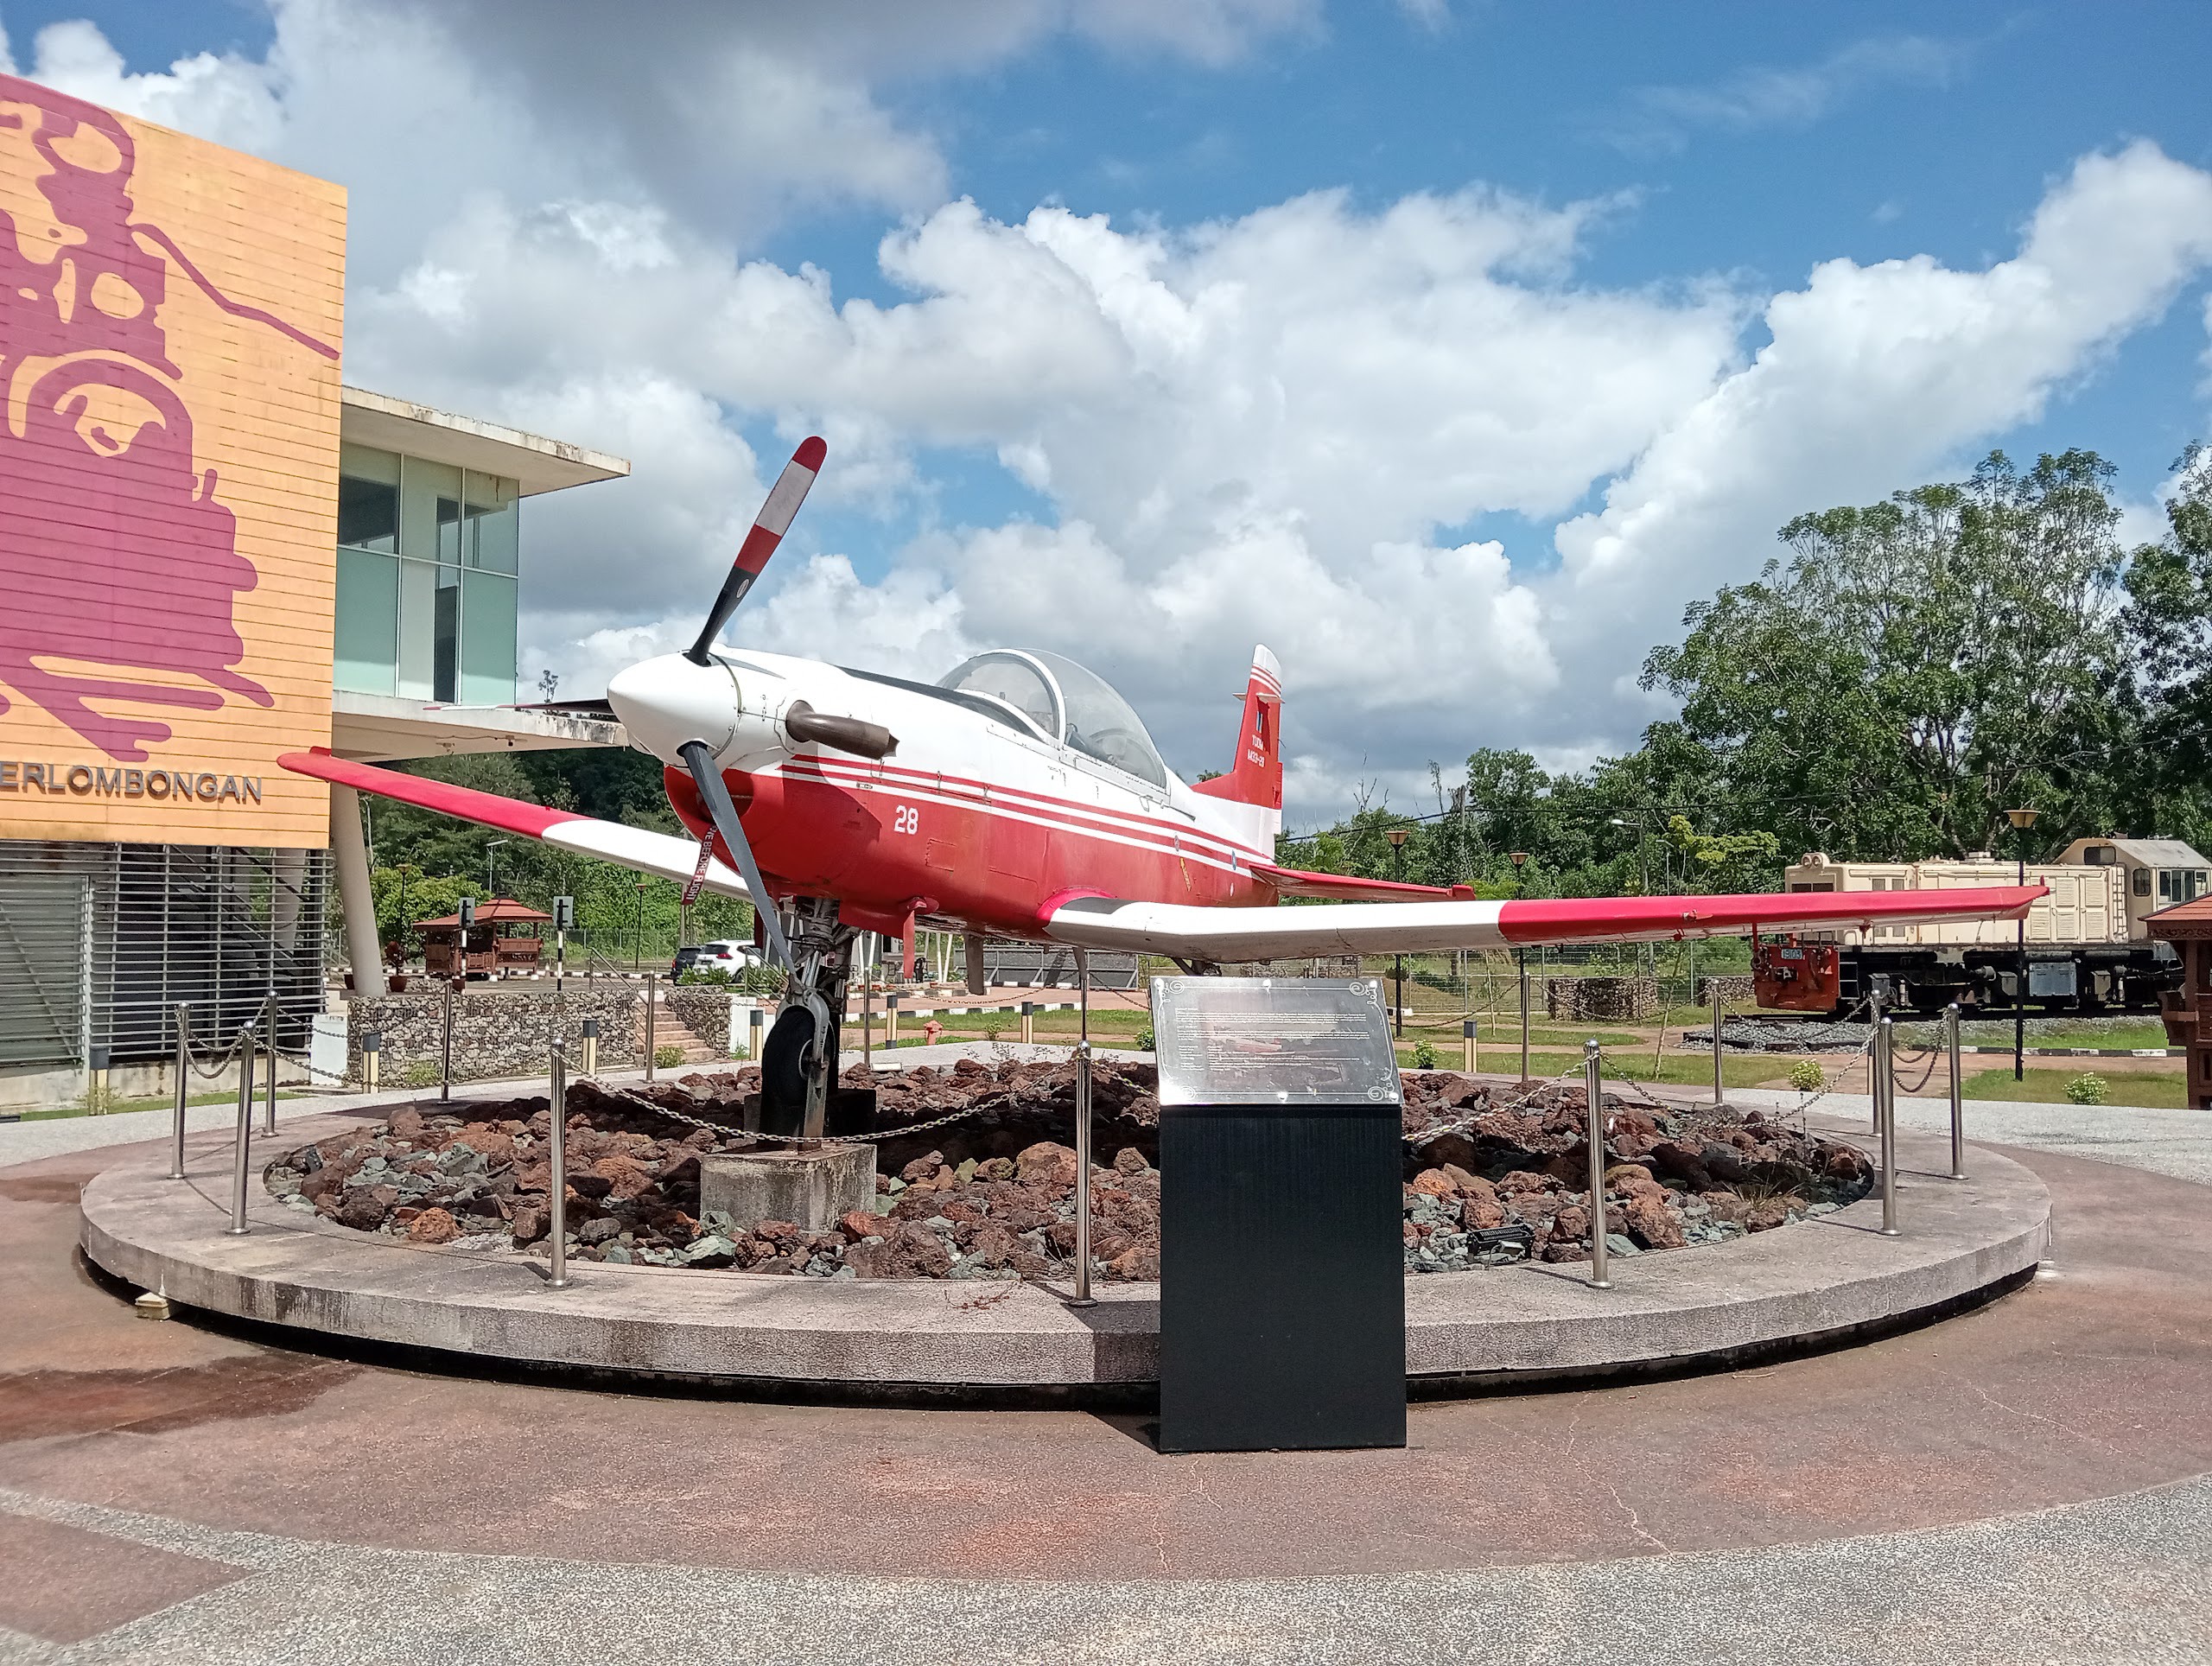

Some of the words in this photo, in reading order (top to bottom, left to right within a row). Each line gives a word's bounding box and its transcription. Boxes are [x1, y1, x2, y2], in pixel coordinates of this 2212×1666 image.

[0, 760, 262, 803] ERLOMBONGAN
[894, 804, 918, 835] 28
[696, 841, 713, 874] BEFORE
[685, 874, 704, 900] FLIGHT
